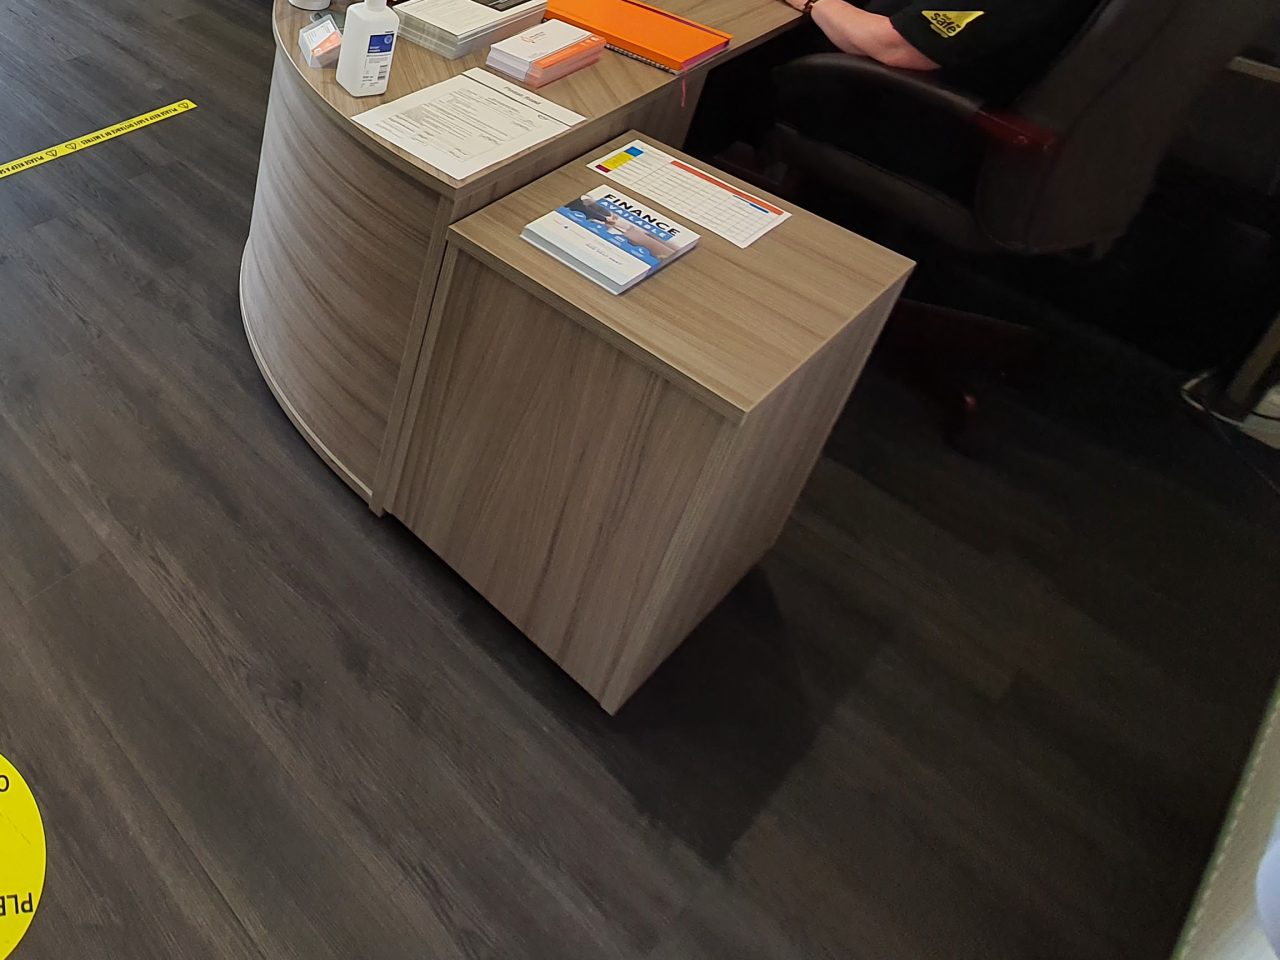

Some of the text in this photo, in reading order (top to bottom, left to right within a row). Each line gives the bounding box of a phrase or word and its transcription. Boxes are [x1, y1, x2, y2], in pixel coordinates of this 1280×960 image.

[931, 12, 956, 34] safe
[10, 162, 25, 171] KEEP
[25, 155, 45, 166] PLEASE
[599, 200, 668, 239] AVAILABLE
[604, 193, 681, 237] FINANCE
